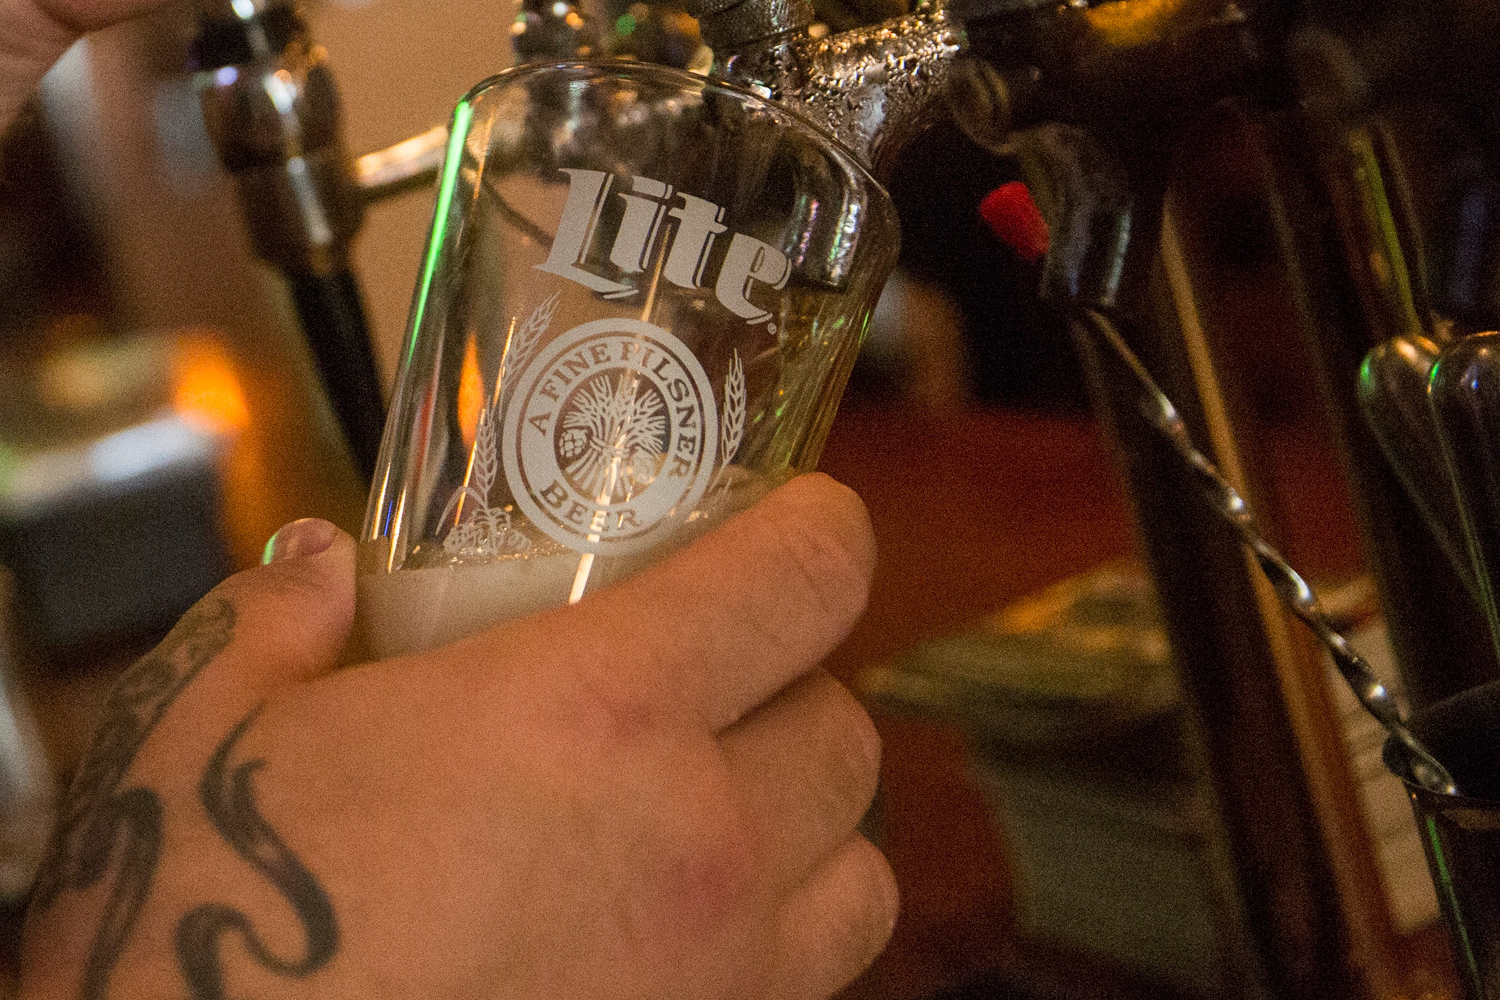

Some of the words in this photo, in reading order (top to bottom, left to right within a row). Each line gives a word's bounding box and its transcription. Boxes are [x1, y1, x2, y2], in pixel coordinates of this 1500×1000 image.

[532, 168, 793, 325] Lite
[539, 342, 613, 402] FINE
[528, 411, 552, 437] A
[619, 340, 698, 479] PILSNER
[539, 479, 643, 532] BEER
